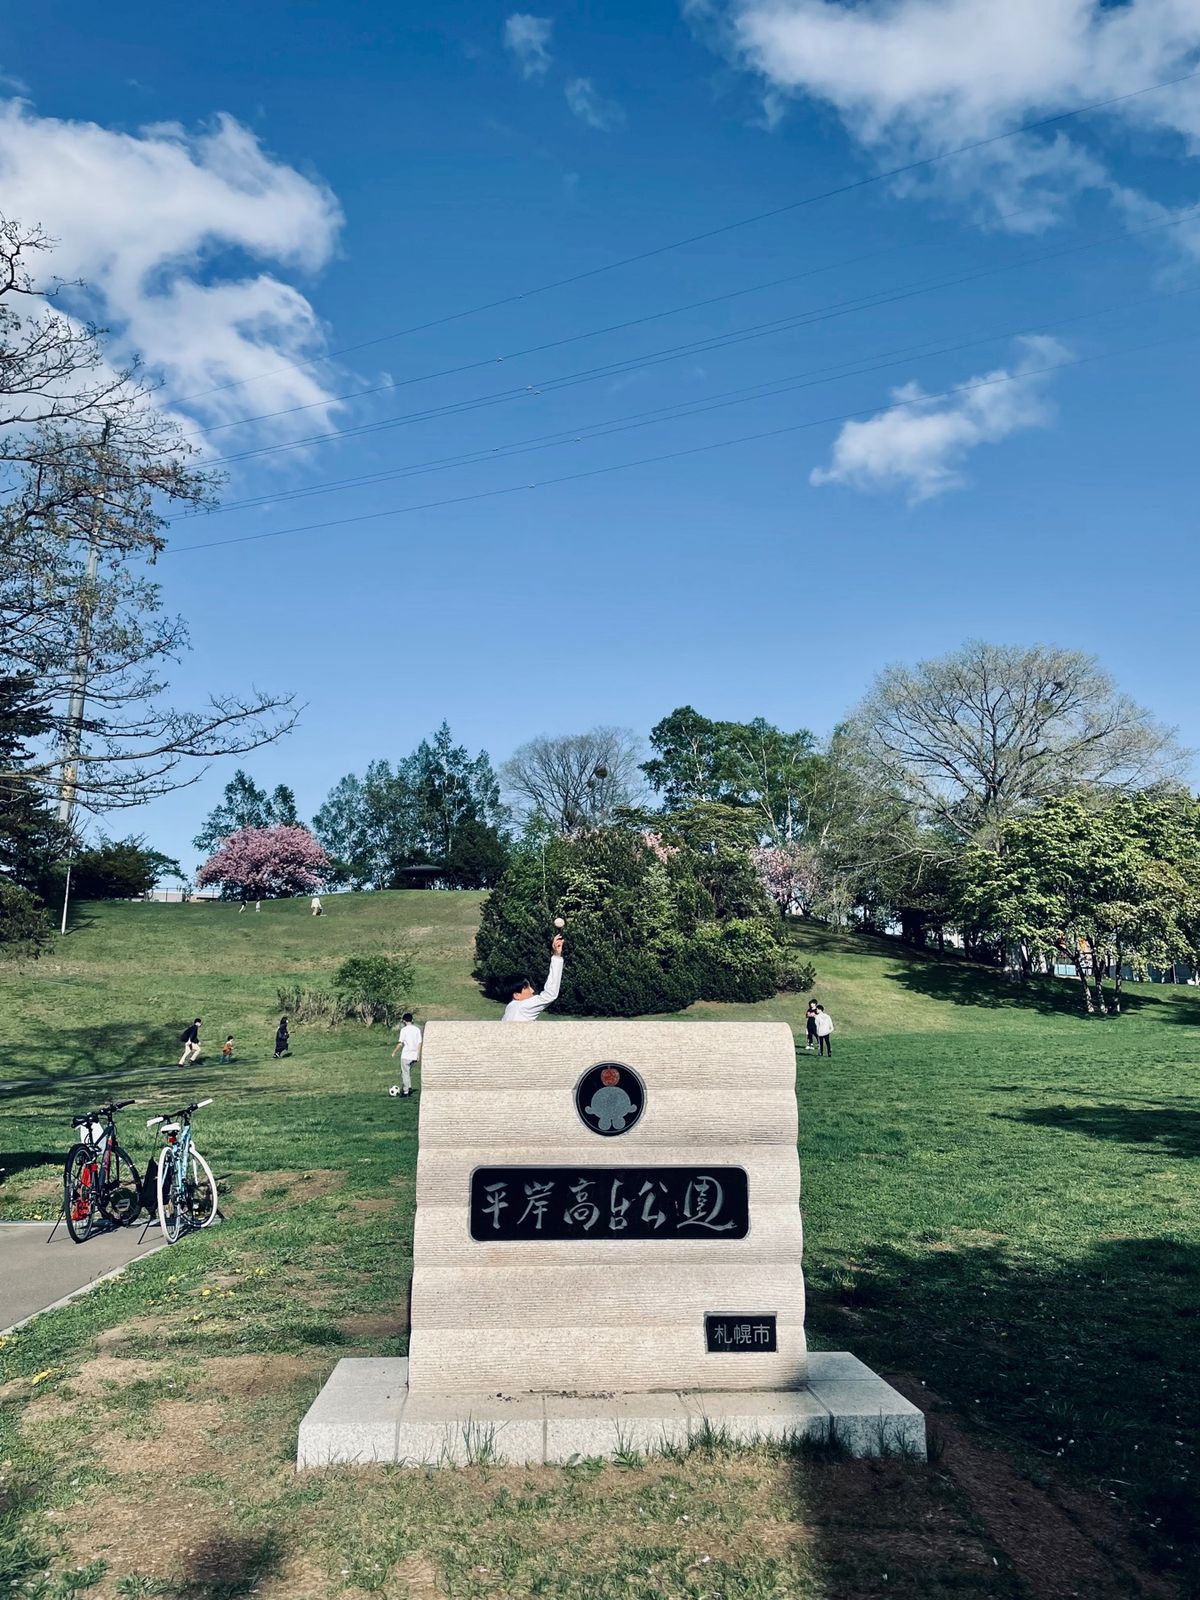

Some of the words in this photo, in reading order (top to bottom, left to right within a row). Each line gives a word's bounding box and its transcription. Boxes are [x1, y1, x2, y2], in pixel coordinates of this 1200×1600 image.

[481, 1175, 737, 1231] 平岸高台公園
[714, 1323, 771, 1344] 札幌市
